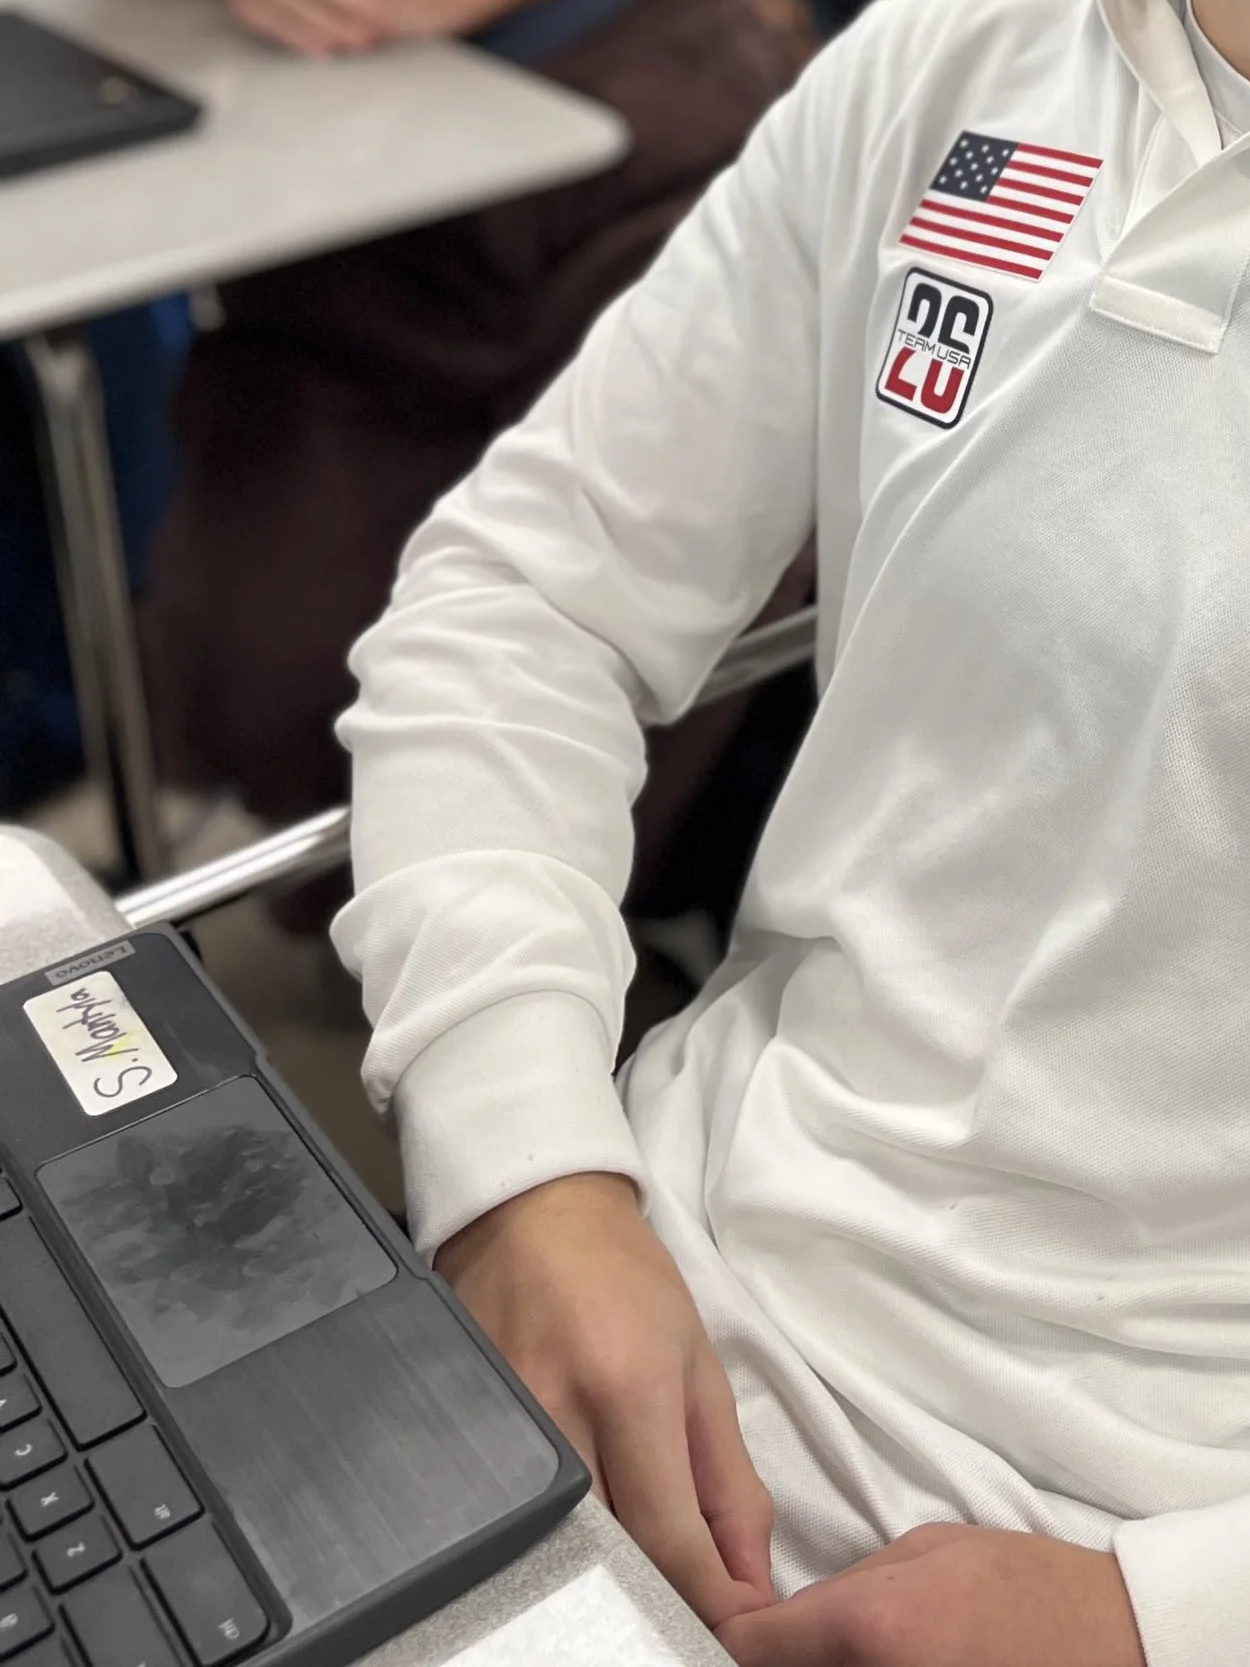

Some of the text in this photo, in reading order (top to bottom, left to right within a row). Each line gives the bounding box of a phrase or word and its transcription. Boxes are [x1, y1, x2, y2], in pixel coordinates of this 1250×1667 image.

[898, 329, 972, 370] TEAM USA
[55, 945, 128, 978] Lenovo
[93, 1058, 153, 1098] S.
[154, 1504, 171, 1520] alt
[218, 1618, 240, 1640] ctrl
